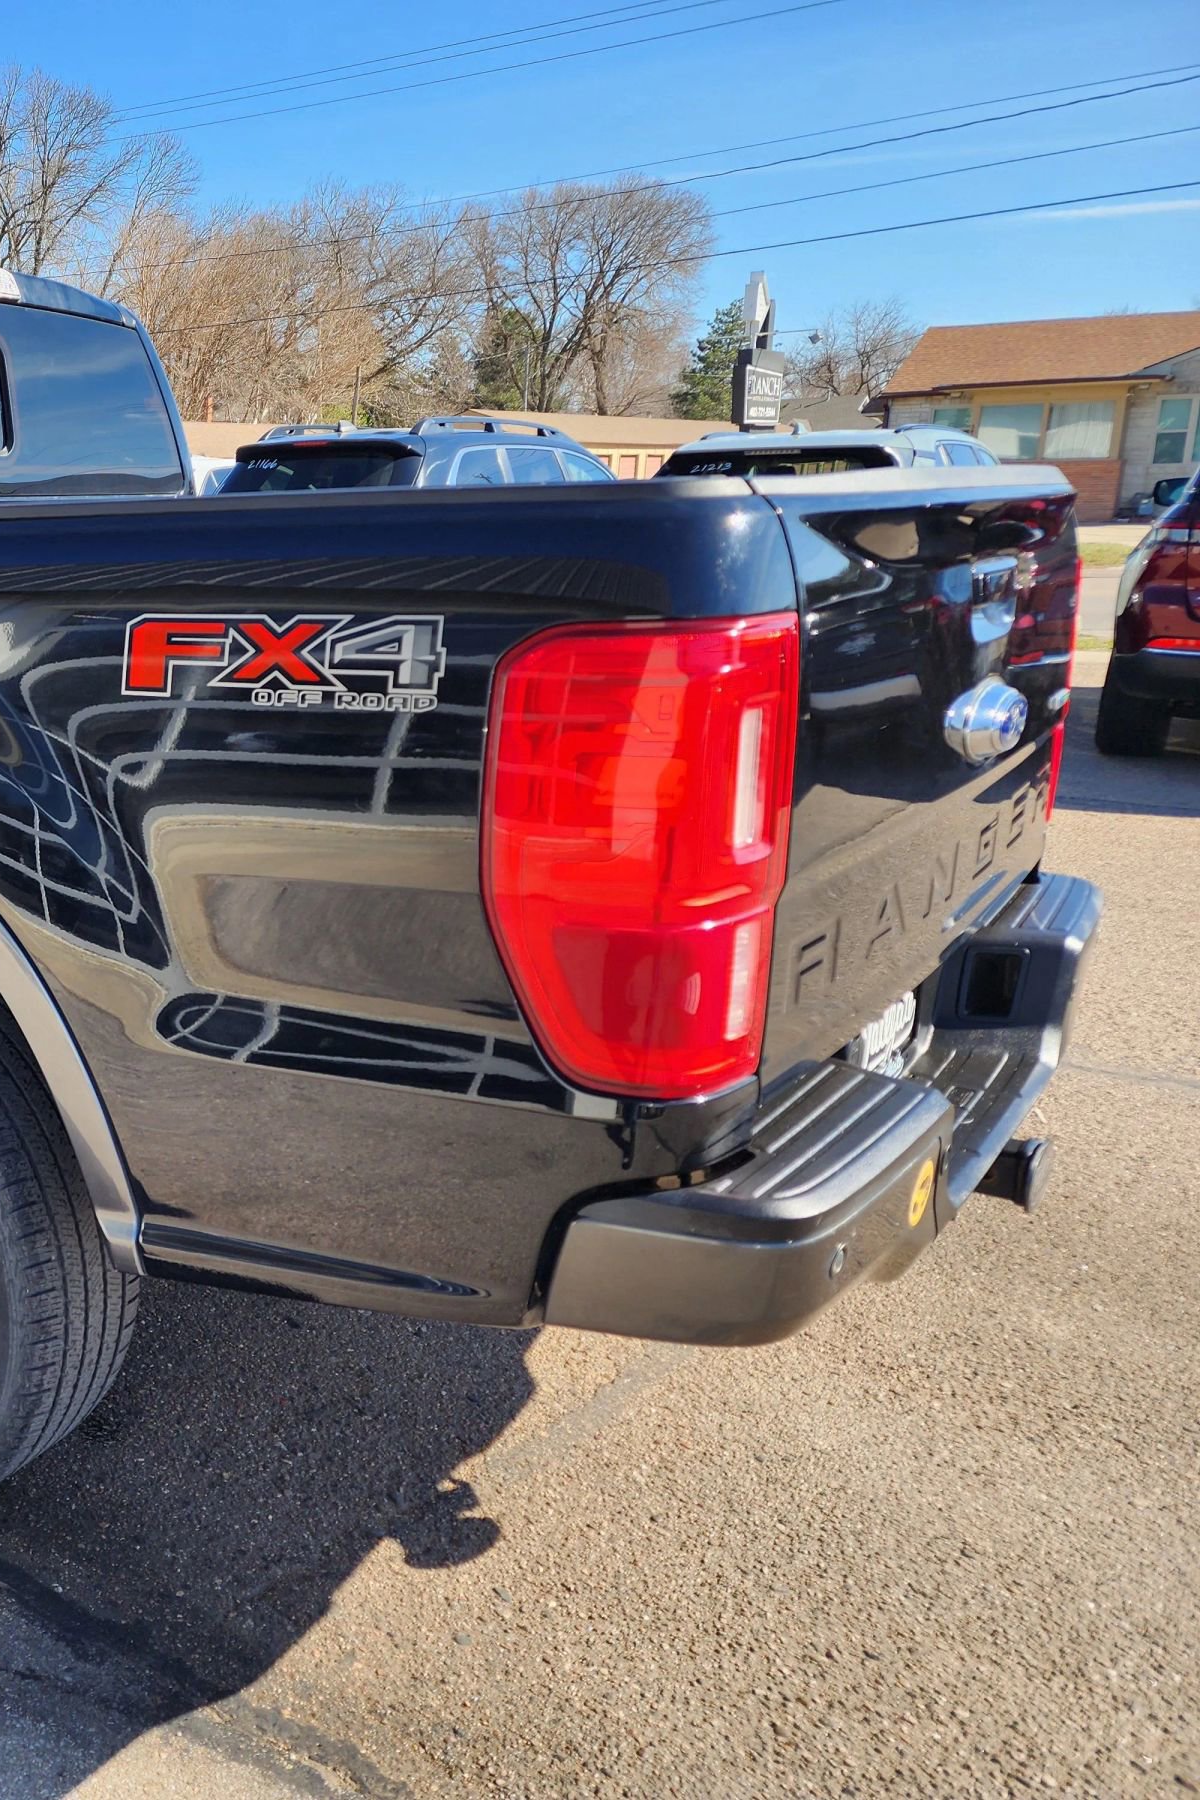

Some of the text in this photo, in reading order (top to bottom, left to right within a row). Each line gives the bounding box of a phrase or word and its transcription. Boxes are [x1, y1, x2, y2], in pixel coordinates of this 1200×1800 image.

[690, 462, 732, 474] 21213
[121, 613, 447, 698] FX4
[251, 688, 438, 713] OFF ROAD
[783, 762, 1051, 1015] RANGER
